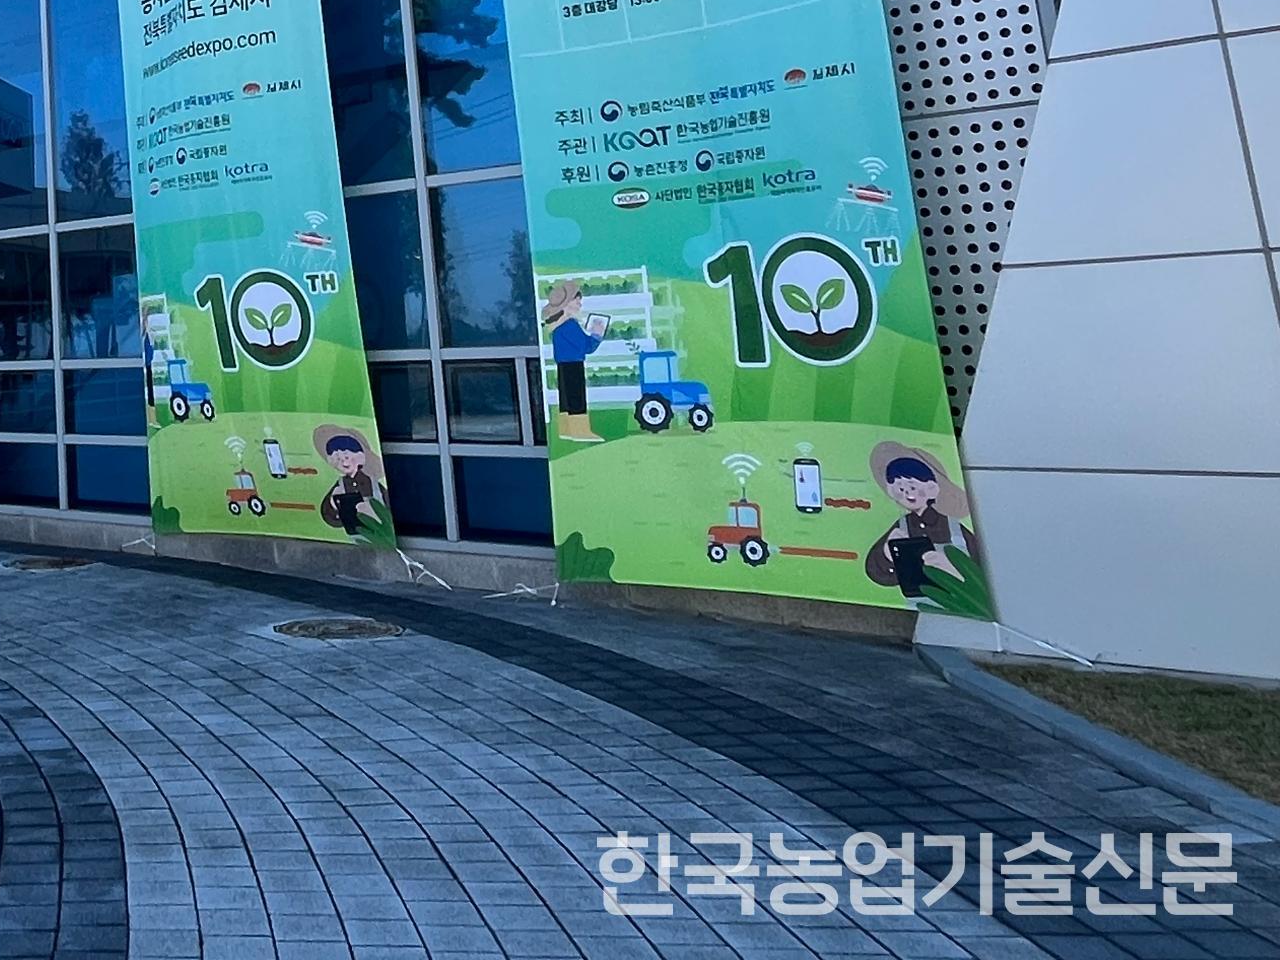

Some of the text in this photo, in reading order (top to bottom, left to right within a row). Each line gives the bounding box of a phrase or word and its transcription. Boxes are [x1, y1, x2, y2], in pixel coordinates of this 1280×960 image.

[555, 108, 584, 127] 주최
[627, 94, 706, 117] 농림축산식품부
[558, 137, 587, 156] 주관
[676, 108, 770, 137] 한국농업기술진흥원
[225, 162, 268, 178] kotra
[561, 165, 591, 184] 후원
[762, 169, 816, 188] kotra
